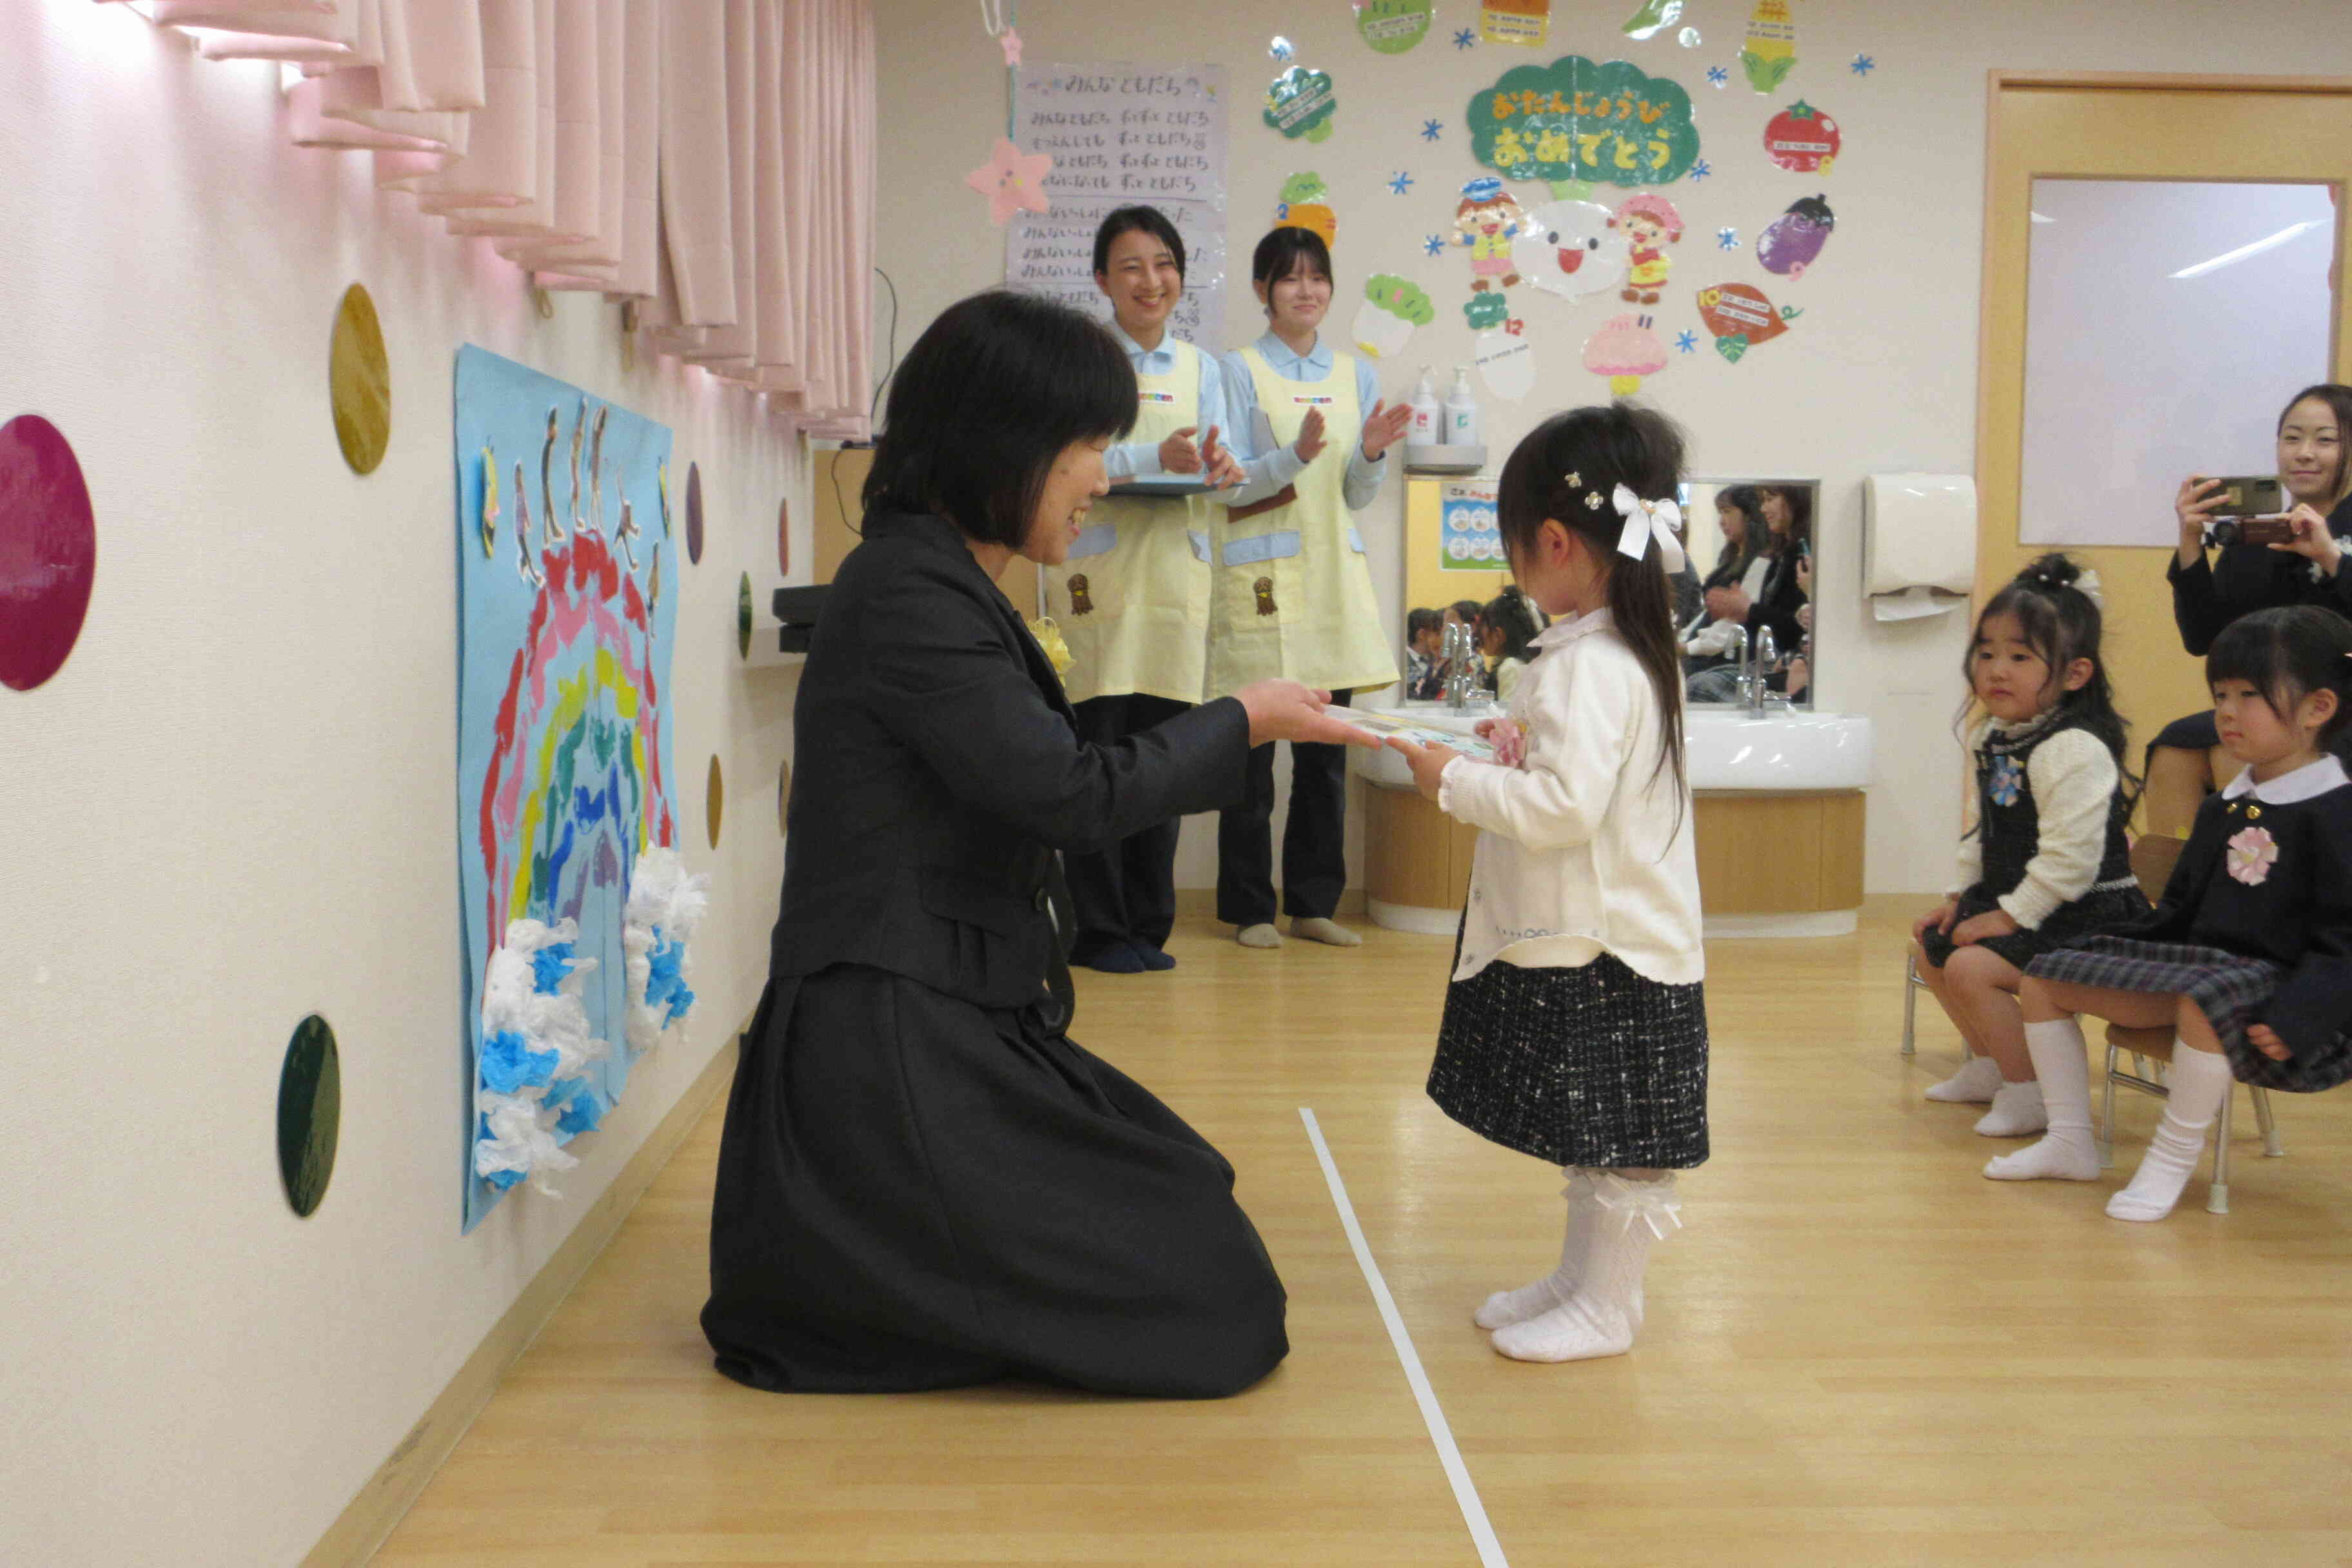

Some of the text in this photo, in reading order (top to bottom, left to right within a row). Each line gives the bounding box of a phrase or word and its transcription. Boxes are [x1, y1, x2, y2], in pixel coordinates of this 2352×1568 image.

[1493, 90, 1672, 124] おたんじょうび
[1494, 127, 1671, 170] おめでとう
[1698, 289, 1720, 307] 10
[1505, 318, 1524, 336] 12
